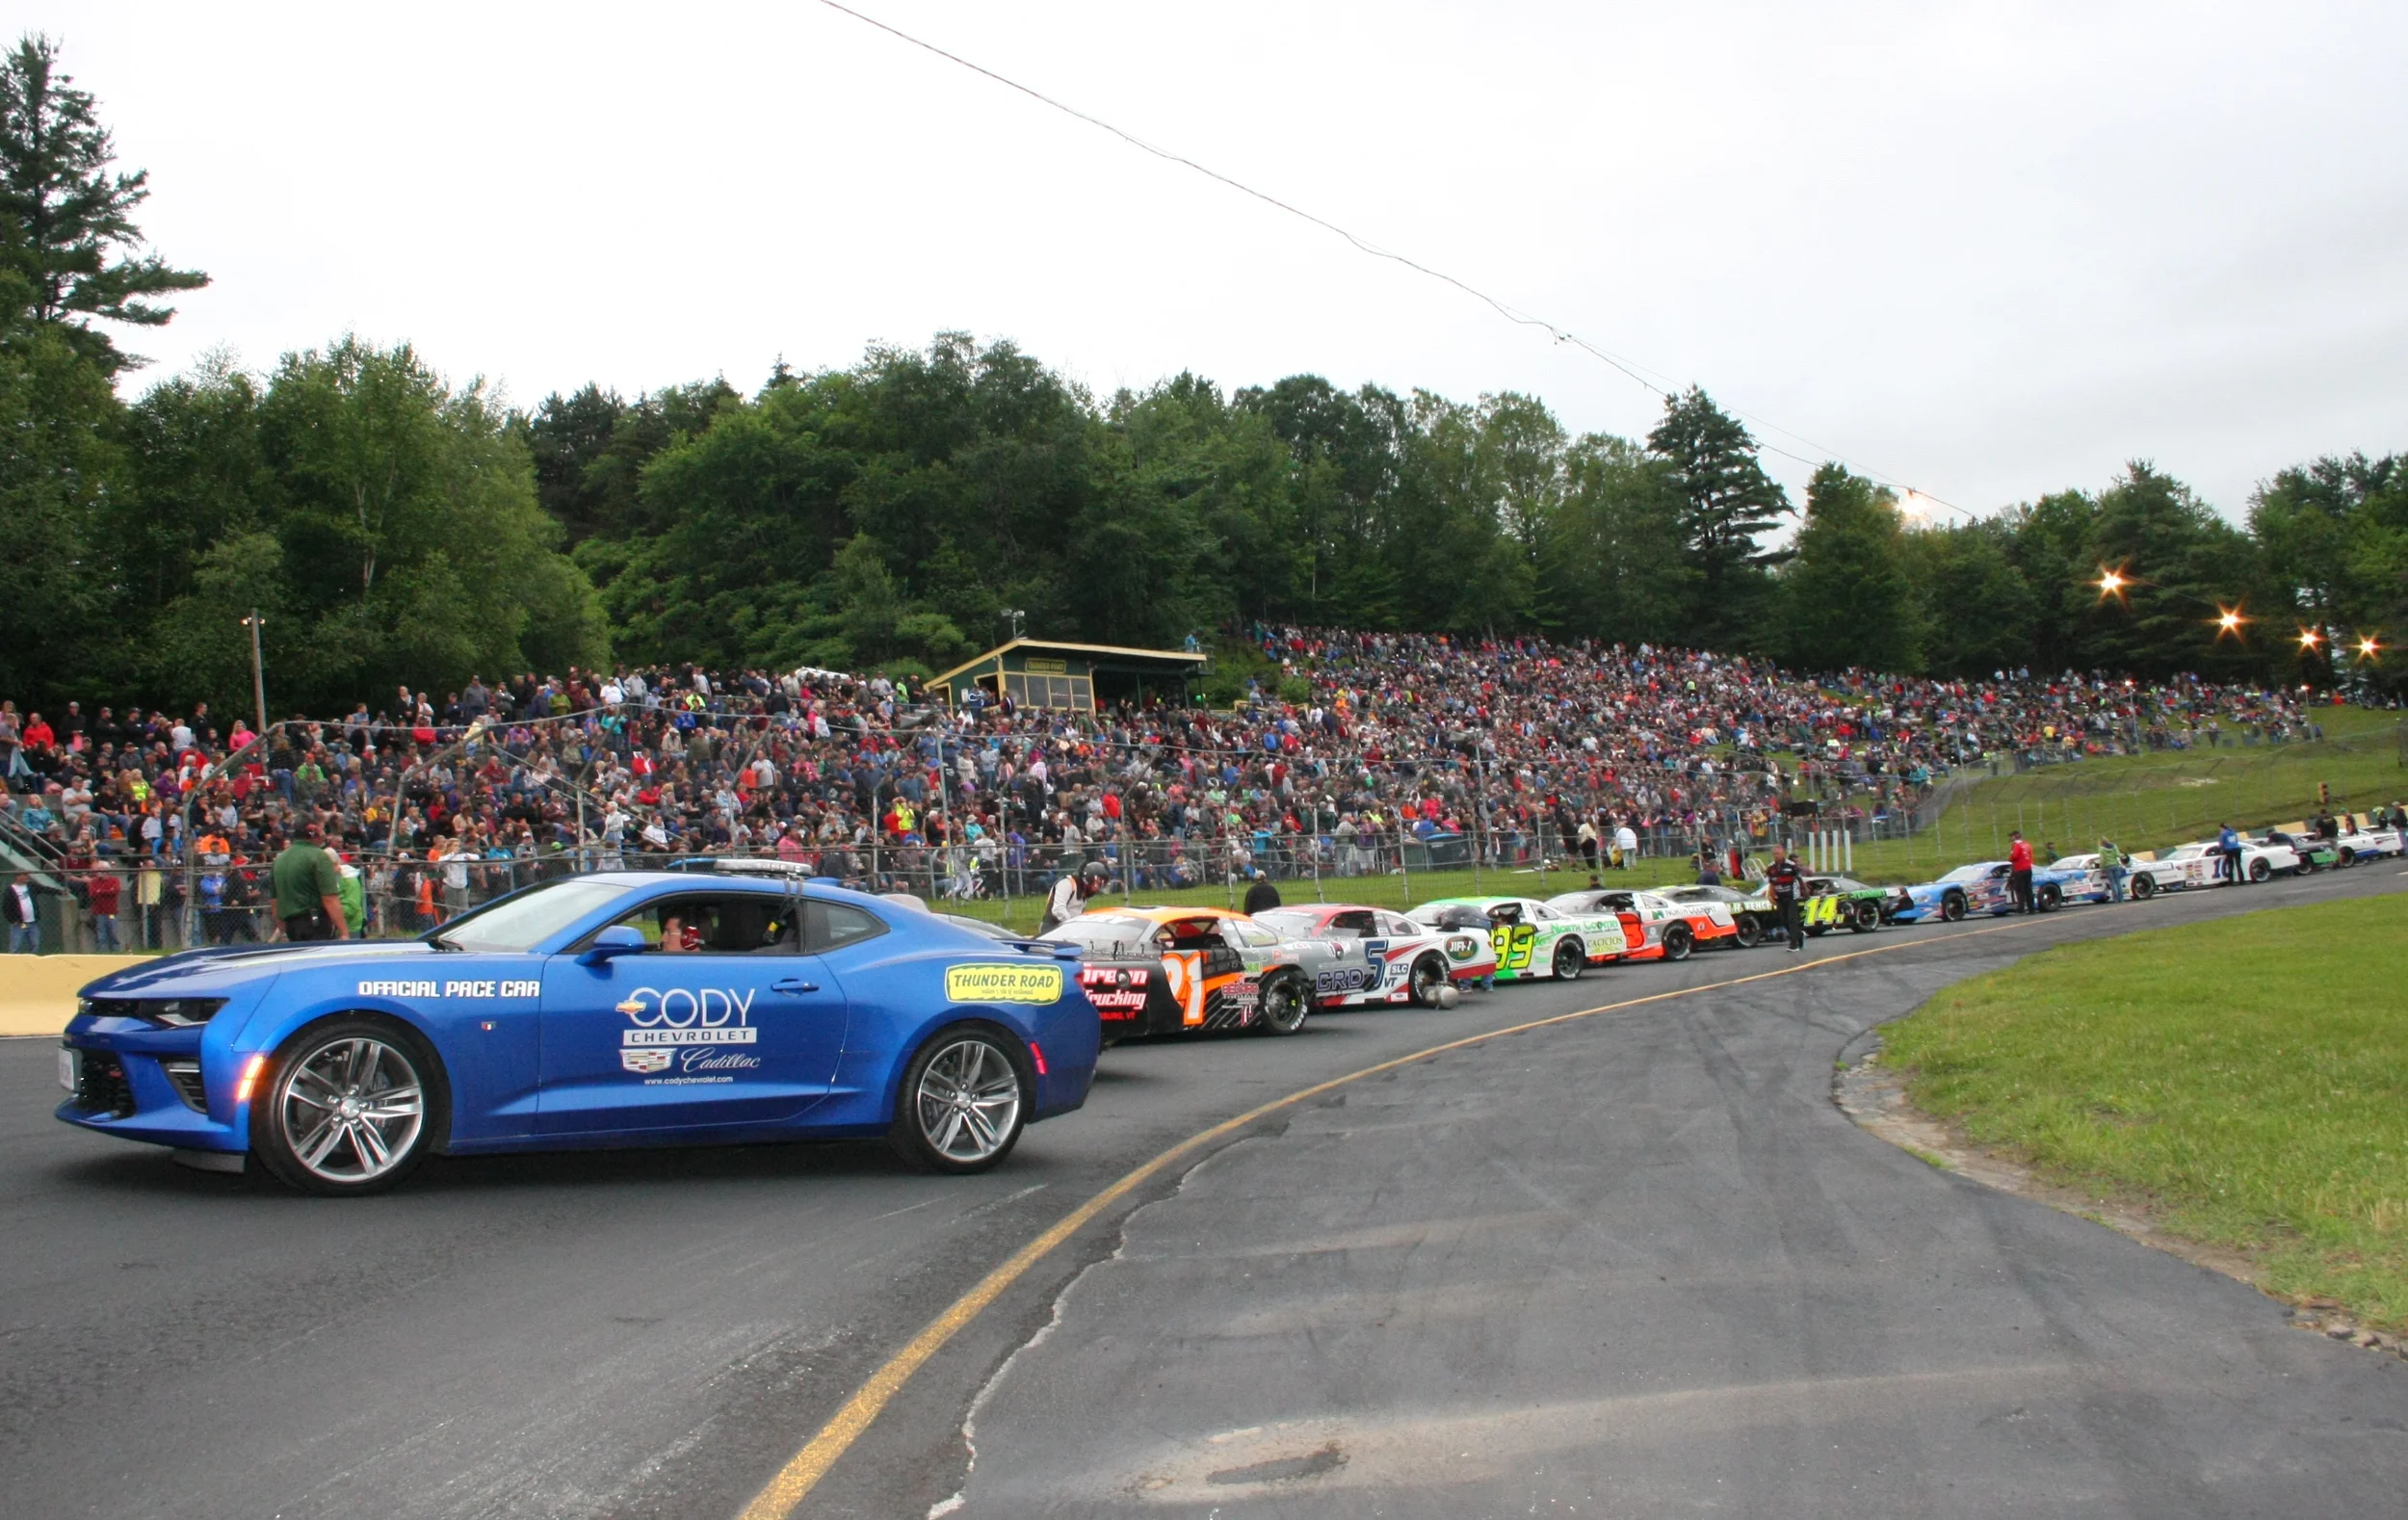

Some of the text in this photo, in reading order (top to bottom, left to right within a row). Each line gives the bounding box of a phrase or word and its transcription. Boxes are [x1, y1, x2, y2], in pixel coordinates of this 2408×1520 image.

[1803, 895, 1838, 926] 14
[1491, 925, 1535, 971] 99
[1365, 938, 1389, 992] 5
[1391, 965, 1408, 974] SLC
[358, 981, 540, 998] OFFICIAL PACE CAR
[954, 974, 1055, 988] THUNDER ROAD
[1384, 977, 1398, 988] VT
[627, 987, 755, 1028] CODY
[631, 1030, 750, 1043] CHEVROLET
[680, 1047, 761, 1073] Cadillac
[643, 1076, 733, 1086] www.codychevrolet.com
